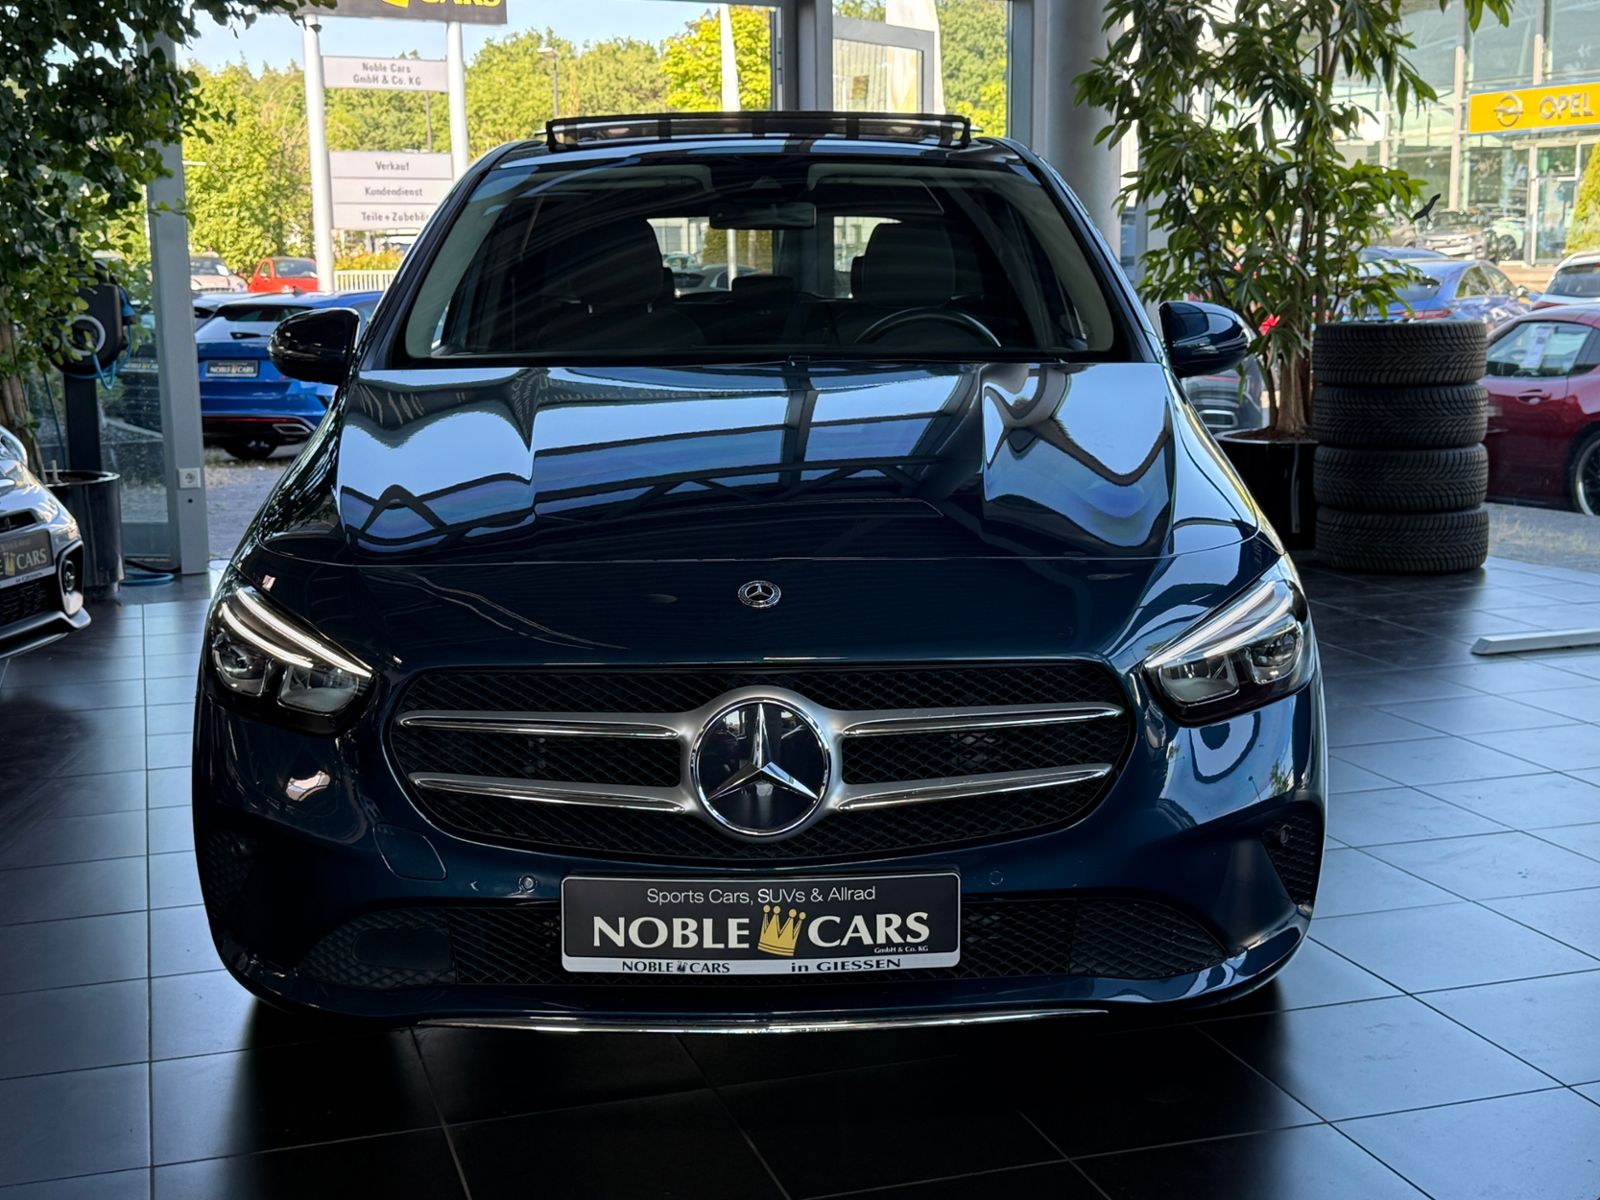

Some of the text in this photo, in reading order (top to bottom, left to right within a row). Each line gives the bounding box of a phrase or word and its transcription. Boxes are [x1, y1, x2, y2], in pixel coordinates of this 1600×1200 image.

[362, 62, 411, 73] Noble Cars
[353, 74, 422, 86] GmbH & Co. KG
[1539, 92, 1594, 120] OPEL
[375, 161, 410, 171] Verkauf
[364, 187, 423, 196] Kundendienst
[16, 548, 47, 569] CARS
[647, 885, 876, 906] Sports Cars, SUVs & Allrad
[593, 912, 930, 949] NOBLE CARS
[622, 961, 730, 973] NOBLE CARS
[791, 959, 901, 972] in GIESSEN
